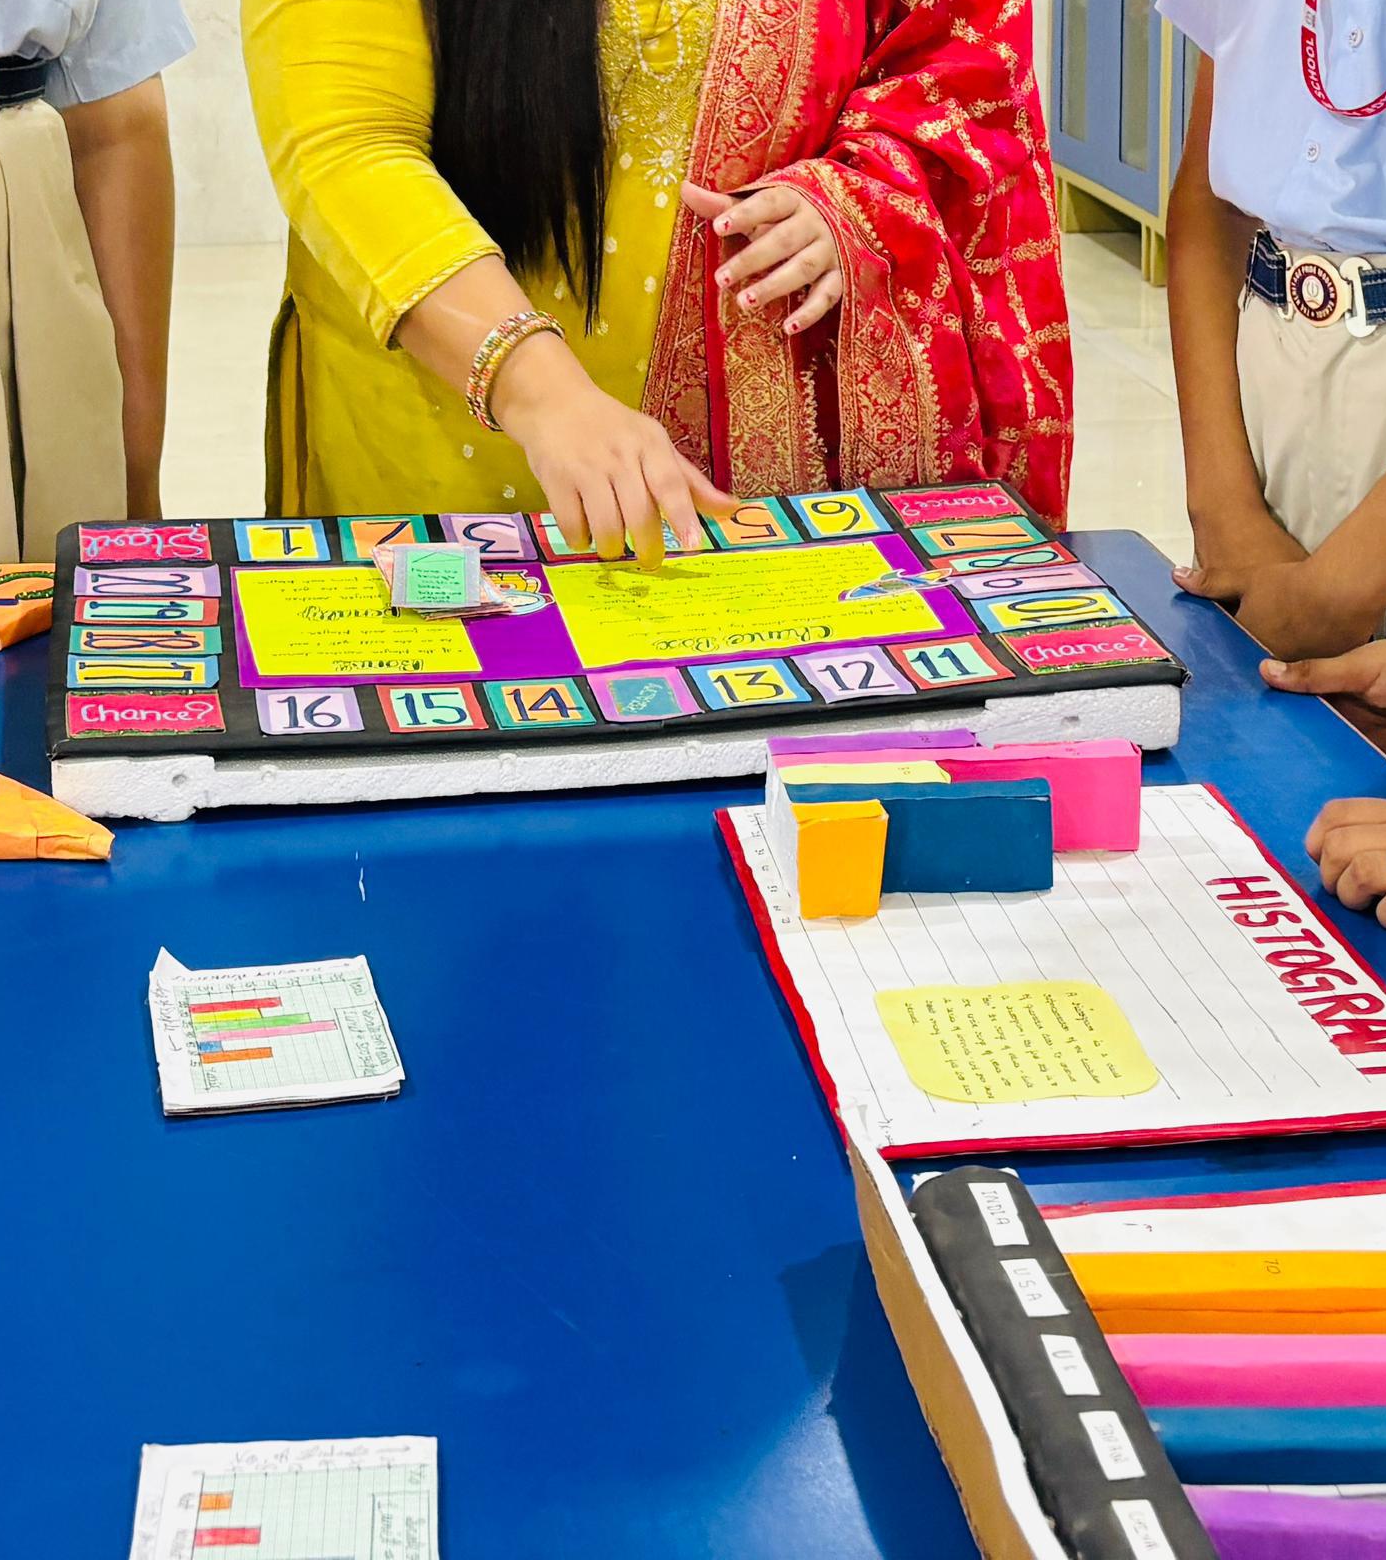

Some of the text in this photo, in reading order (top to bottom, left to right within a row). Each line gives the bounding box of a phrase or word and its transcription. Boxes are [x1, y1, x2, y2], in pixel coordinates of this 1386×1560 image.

[1306, 37, 1326, 103] SCHOOL
[901, 495, 1009, 516] Chance?
[653, 624, 833, 653] Chance Box
[1024, 635, 1147, 662] Chance?
[821, 659, 891, 694] 12
[910, 648, 978, 680] 11
[713, 670, 785, 705] 13
[80, 701, 213, 721] Chance?
[276, 694, 341, 729] 16
[395, 691, 467, 725] 15
[507, 688, 585, 722] 14
[981, 1190, 1010, 1226] INDIA
